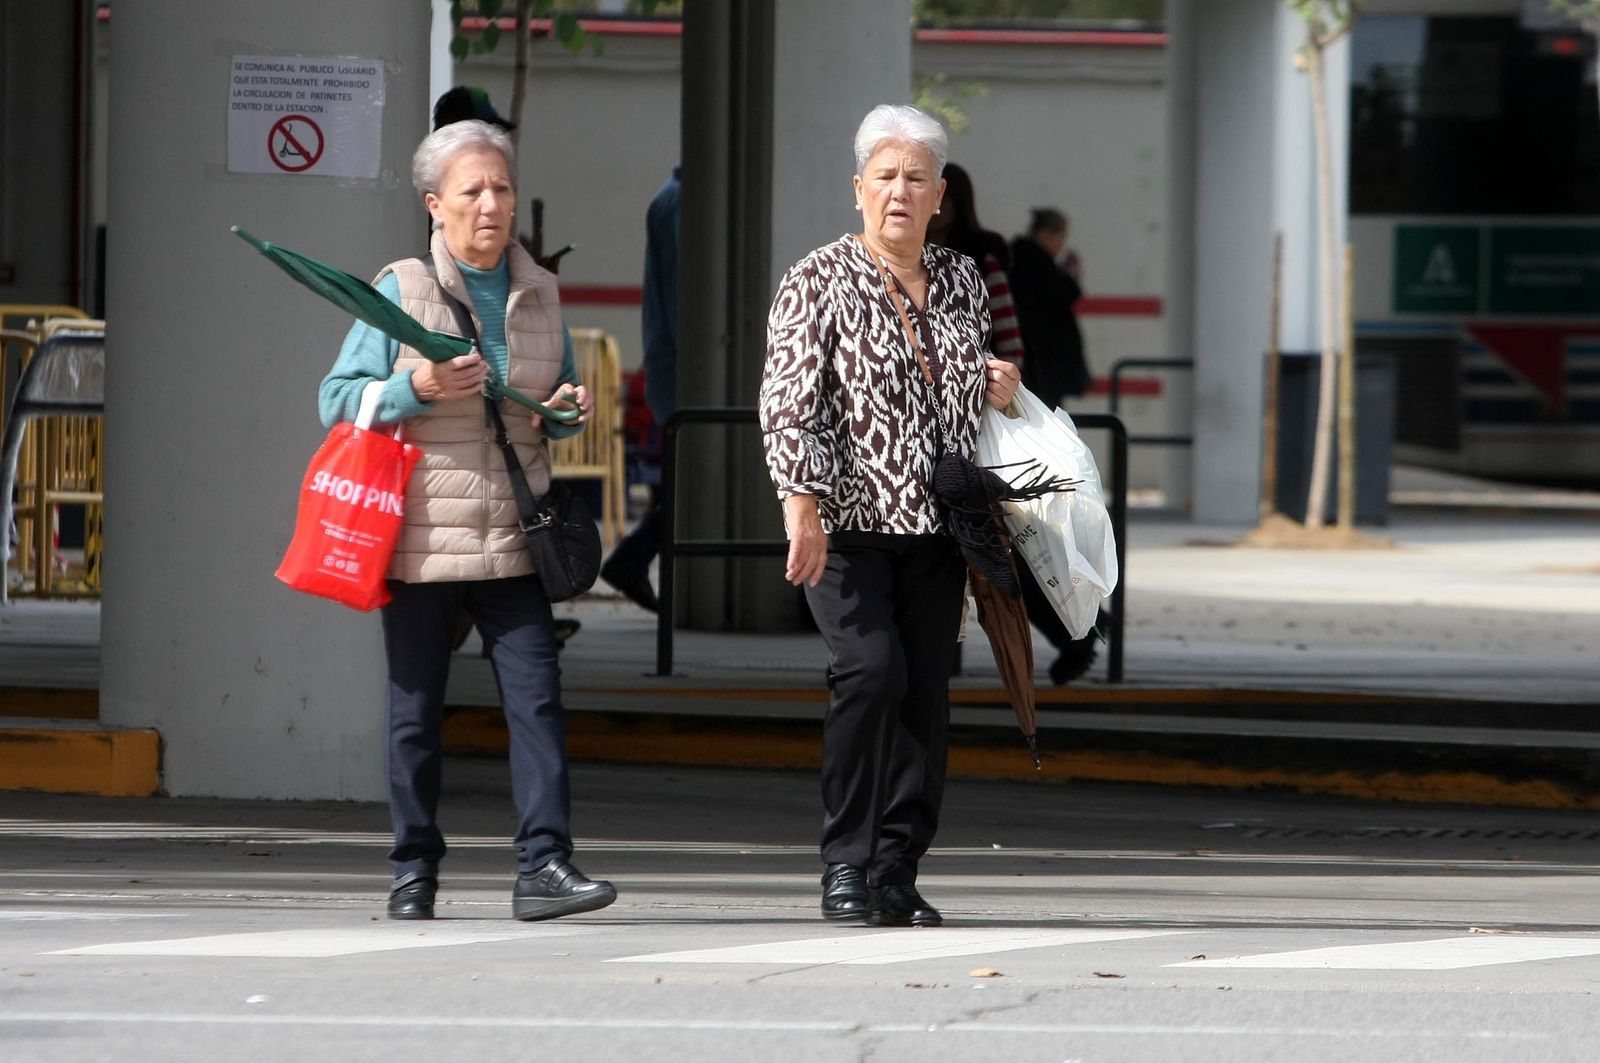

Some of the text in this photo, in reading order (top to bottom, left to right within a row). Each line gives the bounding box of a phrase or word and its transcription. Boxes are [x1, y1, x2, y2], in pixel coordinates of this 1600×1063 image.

[234, 62, 376, 76] SE COMUNICA AL PUBLICO USUARIO
[234, 76, 370, 89] QUE ESTA TOTALMENTE PROHIBIDO
[233, 89, 352, 102] LA CIRCULACION DE PATINETES
[232, 102, 262, 111] DENTRO
[264, 103, 273, 112] DE
[275, 103, 284, 112] LA
